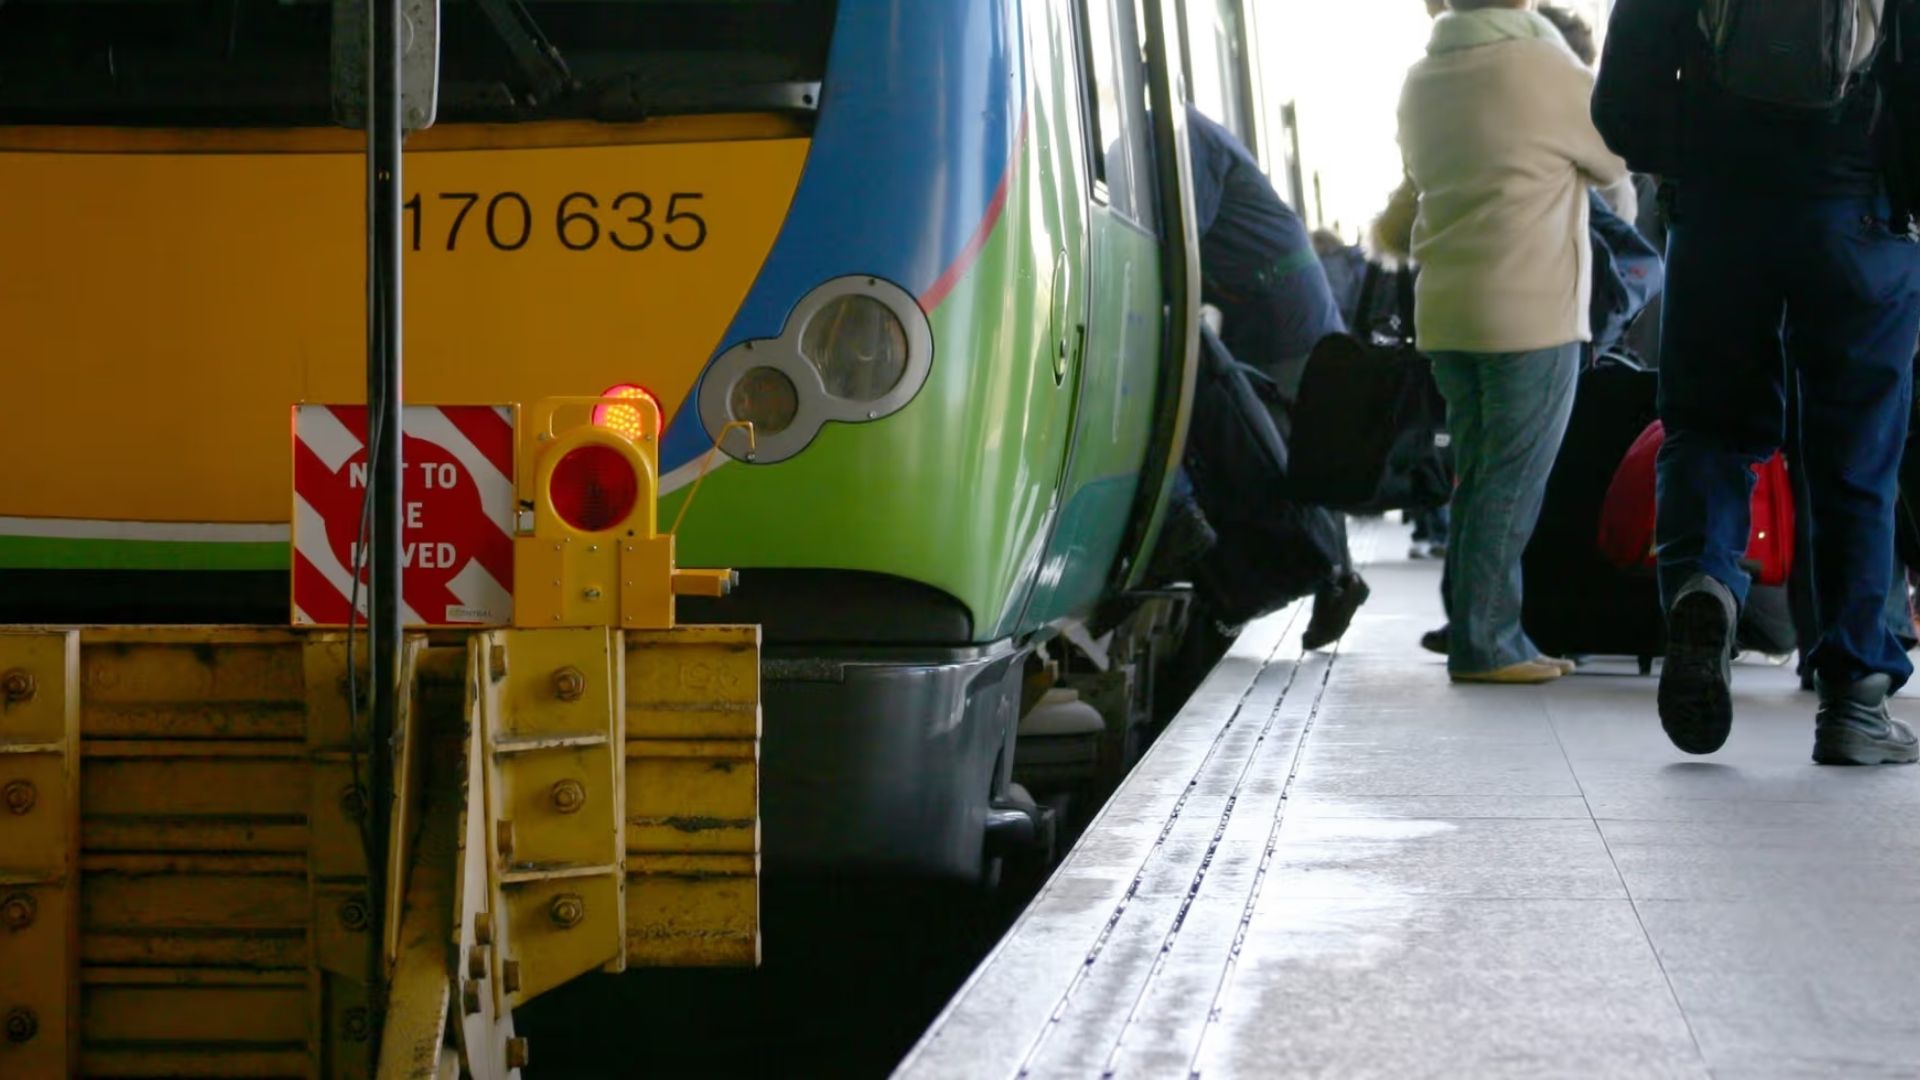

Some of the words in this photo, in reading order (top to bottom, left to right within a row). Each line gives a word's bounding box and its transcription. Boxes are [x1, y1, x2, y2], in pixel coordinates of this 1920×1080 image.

[402, 192, 533, 251] 170
[556, 192, 708, 251] 635
[420, 462, 458, 489] TO
[350, 542, 456, 569] VED
